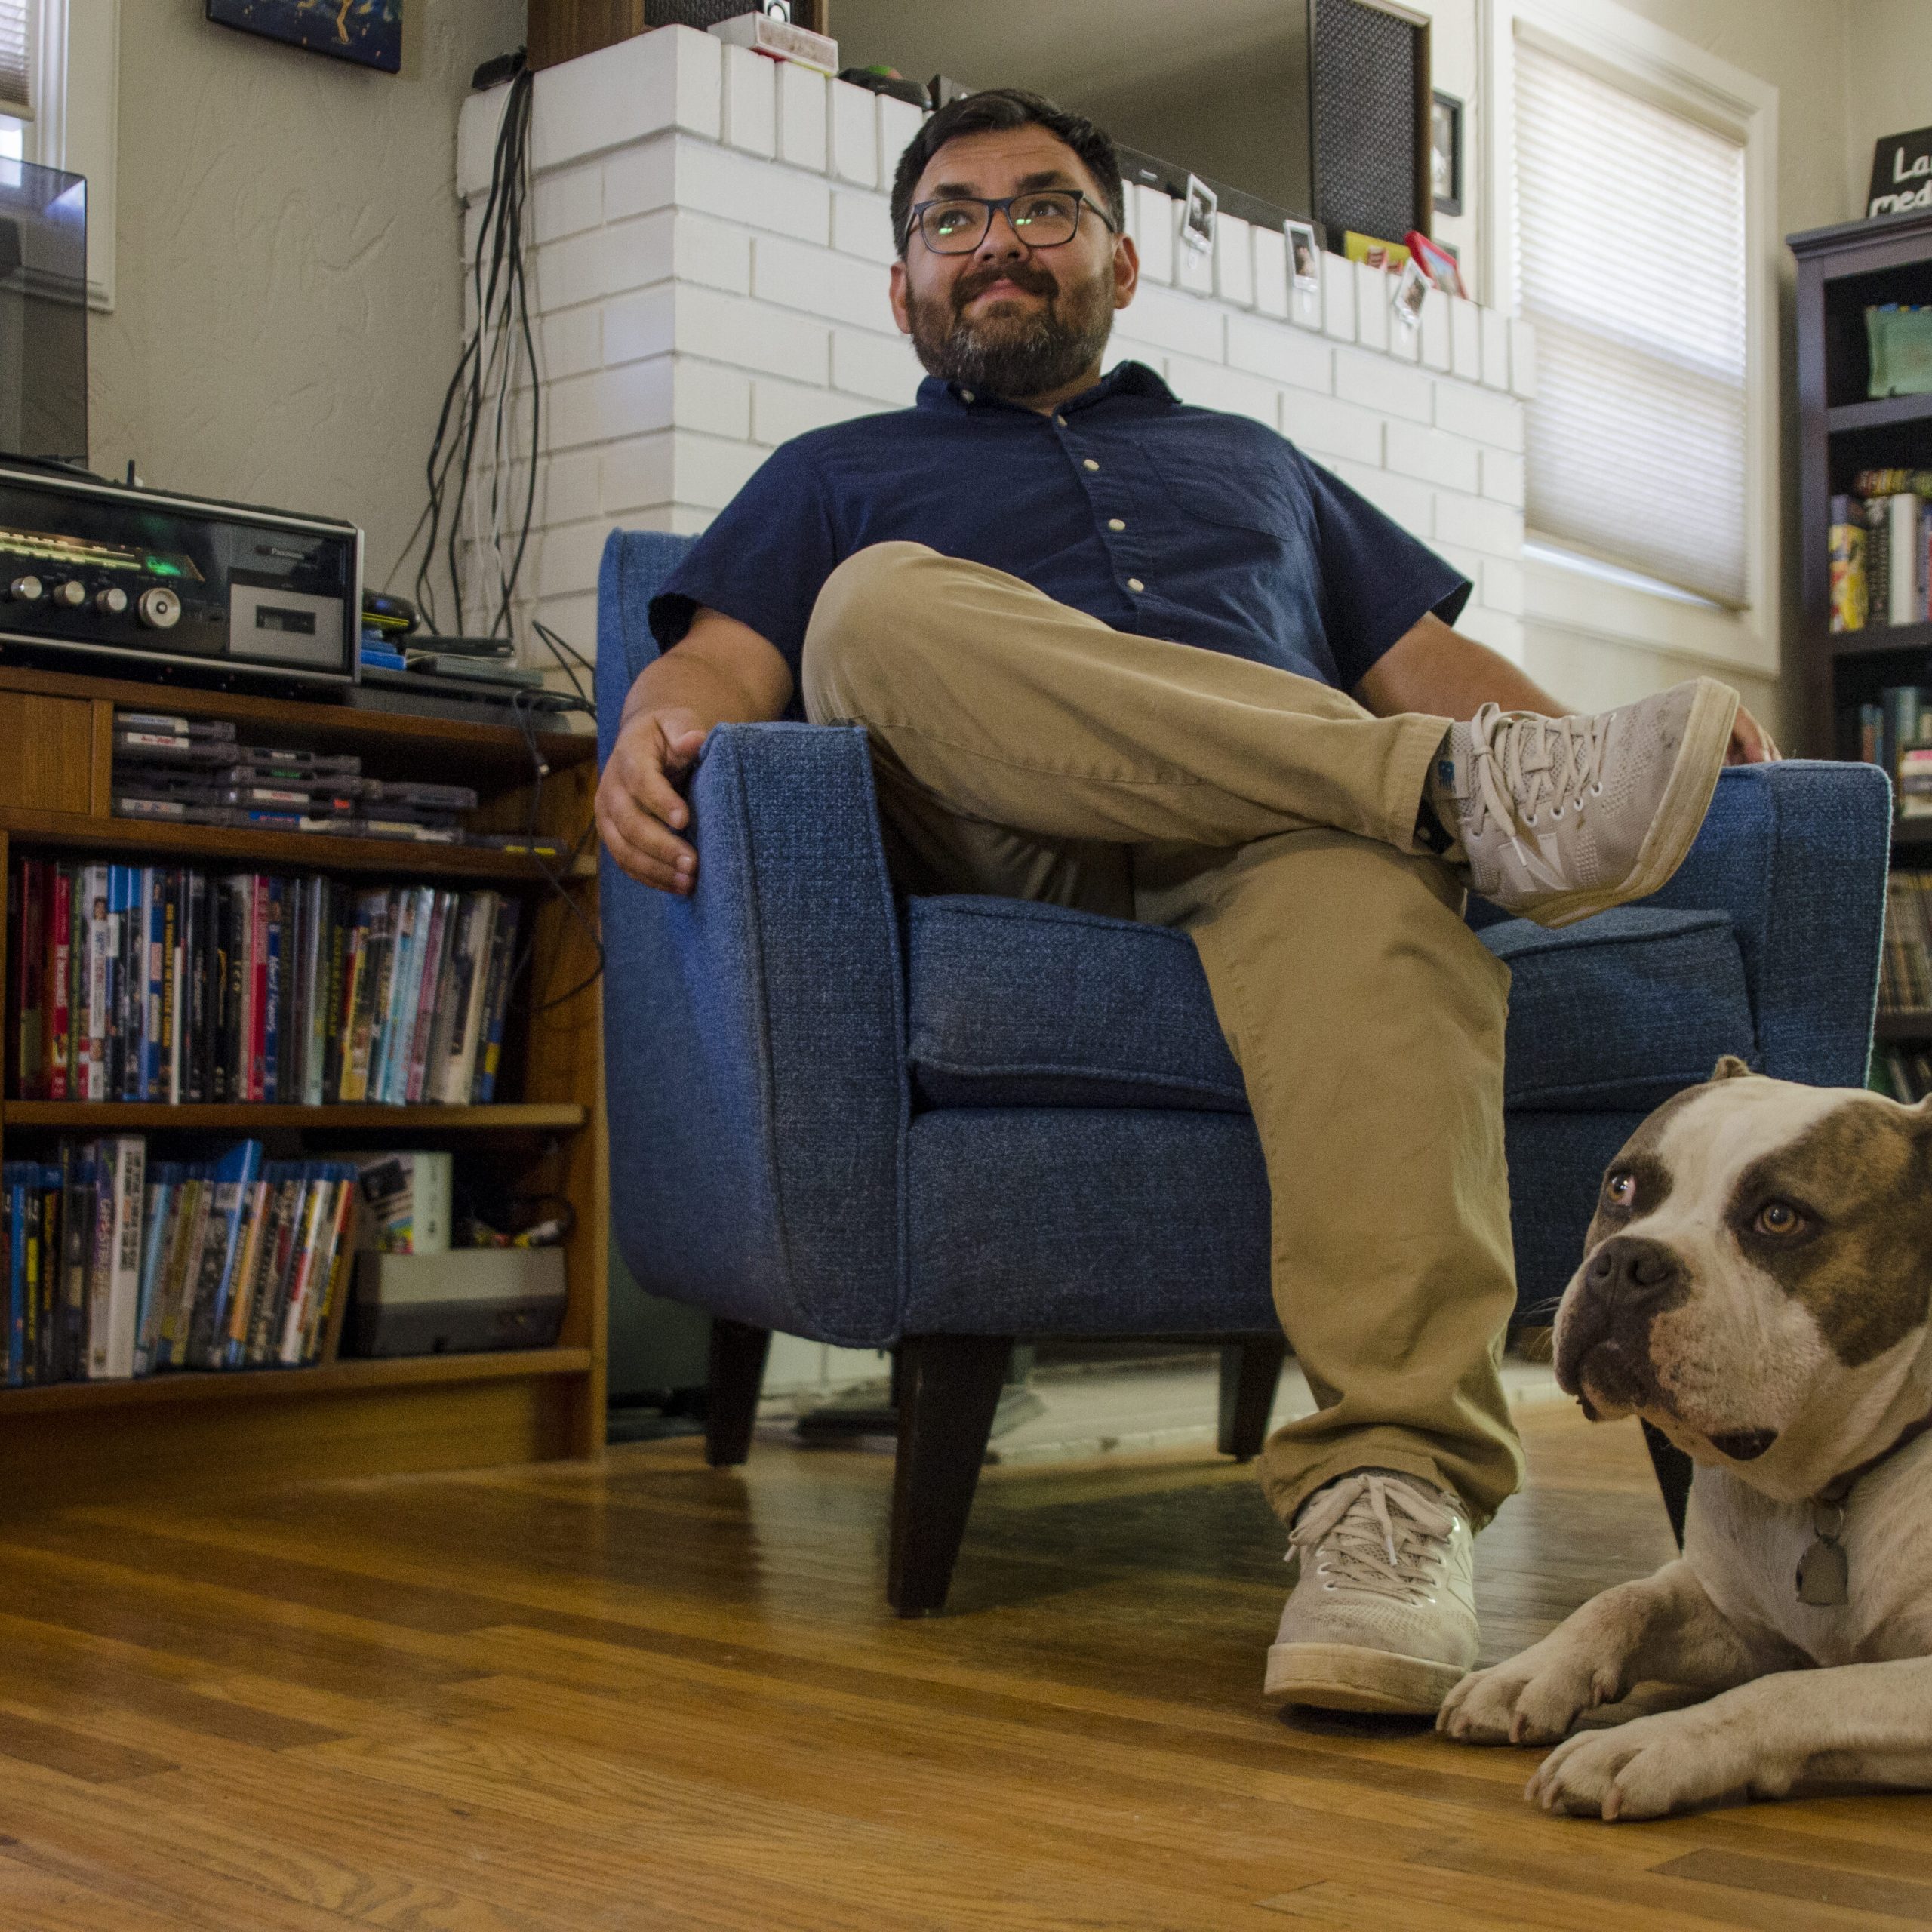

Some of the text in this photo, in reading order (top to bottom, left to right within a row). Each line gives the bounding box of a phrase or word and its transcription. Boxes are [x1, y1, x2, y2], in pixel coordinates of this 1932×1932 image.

[1893, 146, 1932, 183] La
[163, 903, 174, 1048] BIG TROUBLE IN LITTLE CHINA
